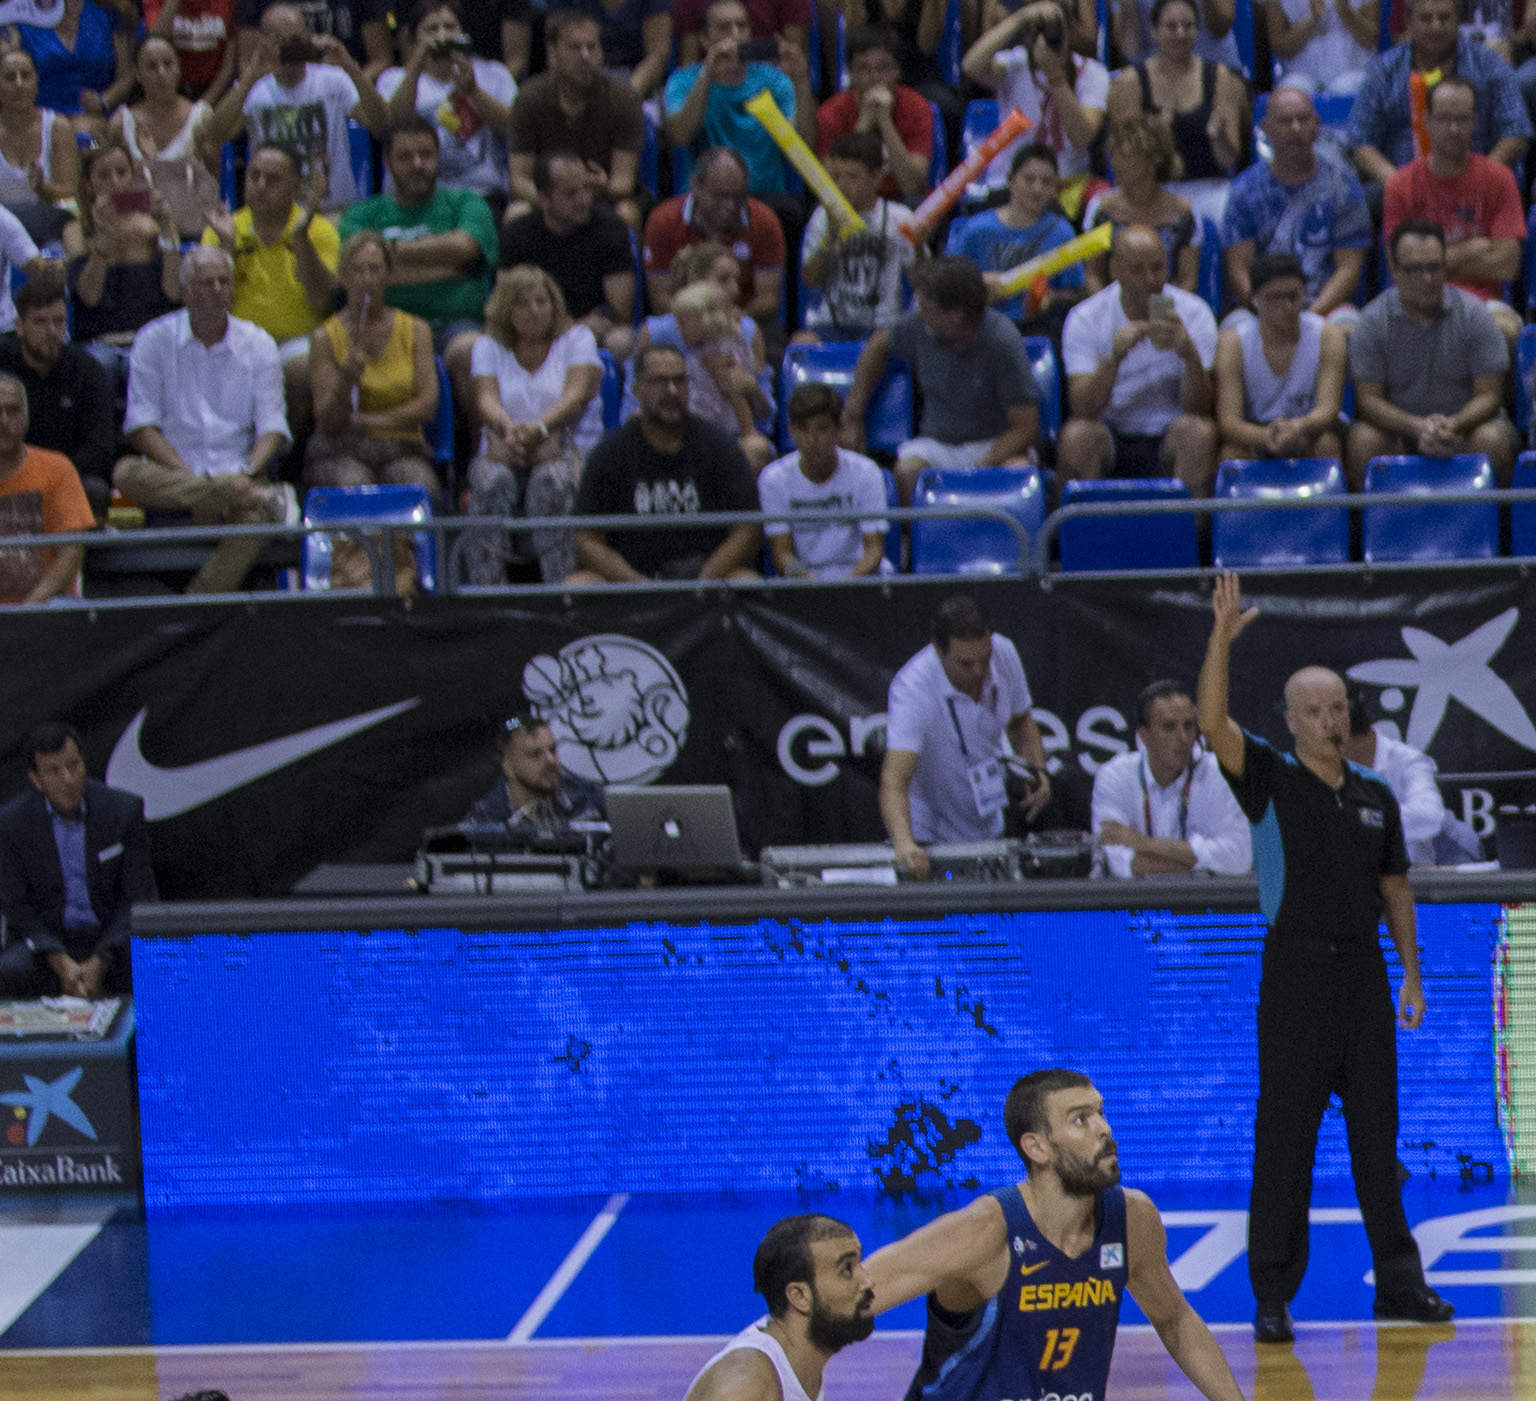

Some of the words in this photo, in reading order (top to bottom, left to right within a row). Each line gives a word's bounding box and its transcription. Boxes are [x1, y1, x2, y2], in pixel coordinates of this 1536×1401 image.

[0, 1155, 123, 1184] aixaBank
[1019, 1276, 1117, 1312] ESPAÑA
[1038, 1327, 1081, 1371] 13
